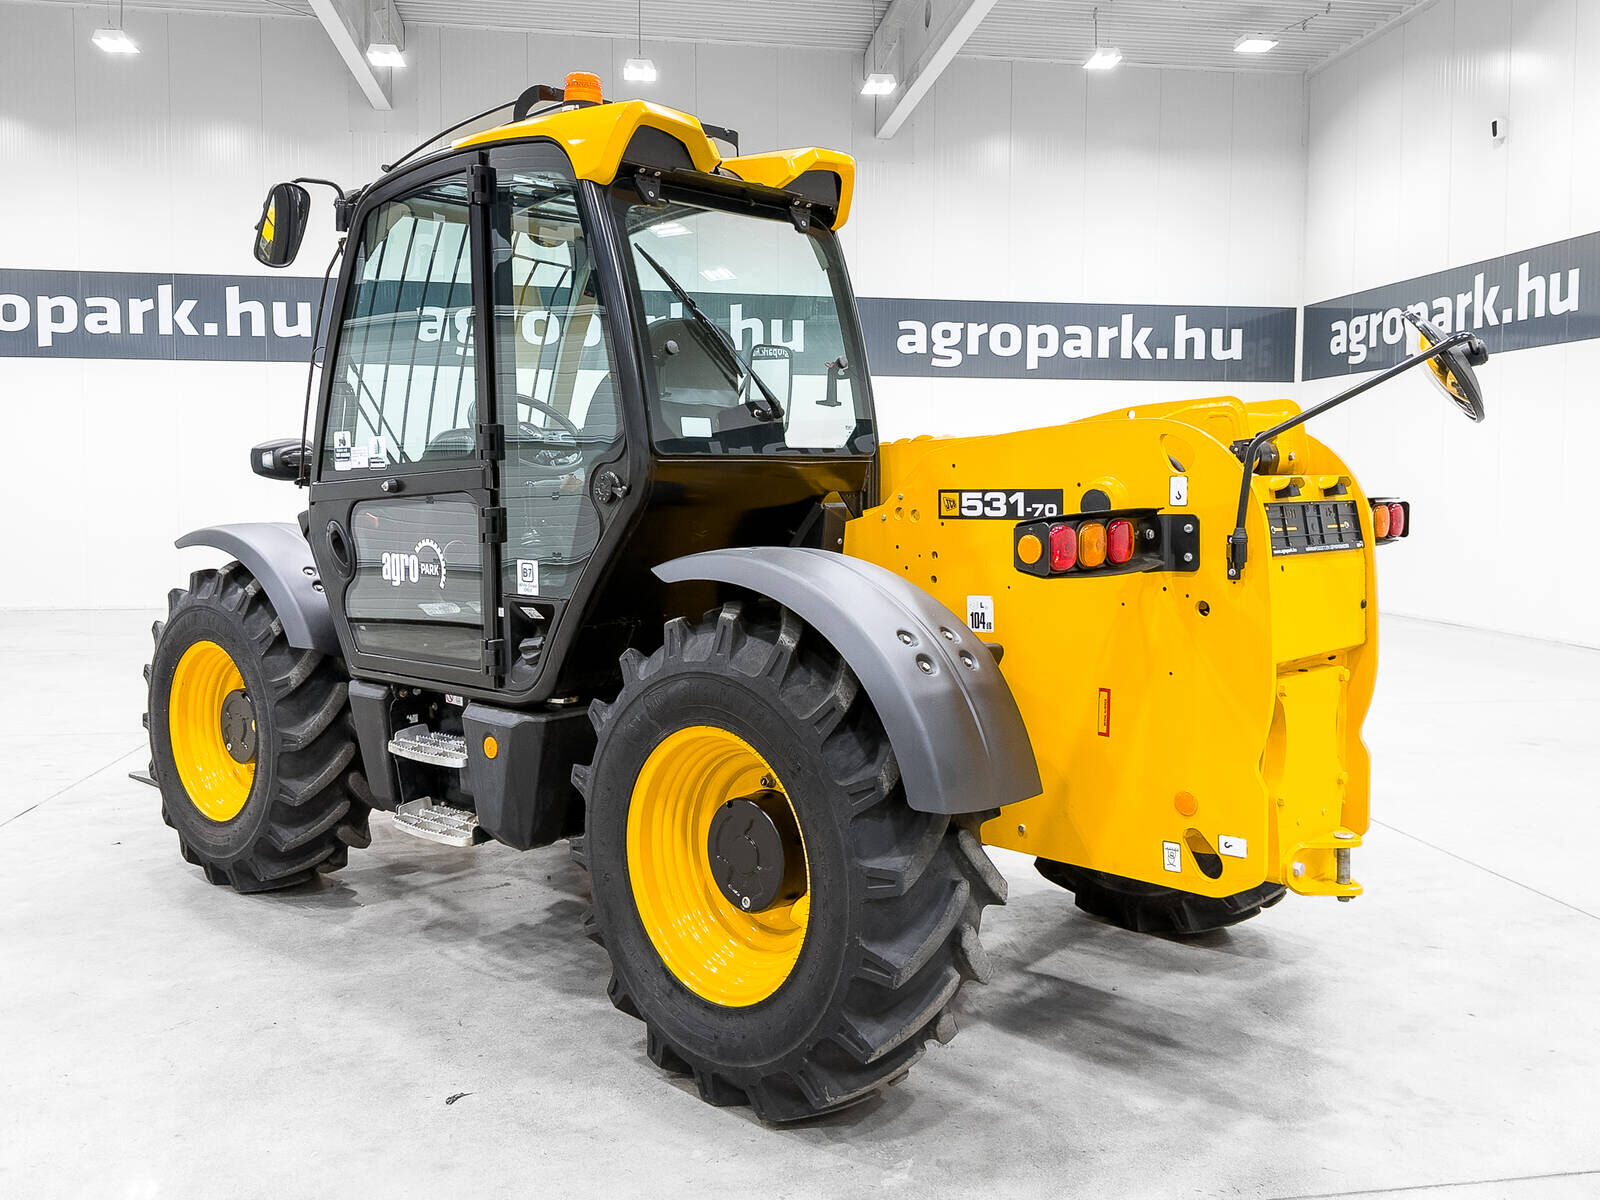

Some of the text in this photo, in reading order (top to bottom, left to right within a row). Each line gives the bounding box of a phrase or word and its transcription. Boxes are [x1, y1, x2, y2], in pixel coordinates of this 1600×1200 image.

[896, 313, 1243, 370] agropark.hu
[961, 491, 1057, 517] 531-70
[381, 552, 440, 587] agro PARK
[970, 611, 985, 630] 104
